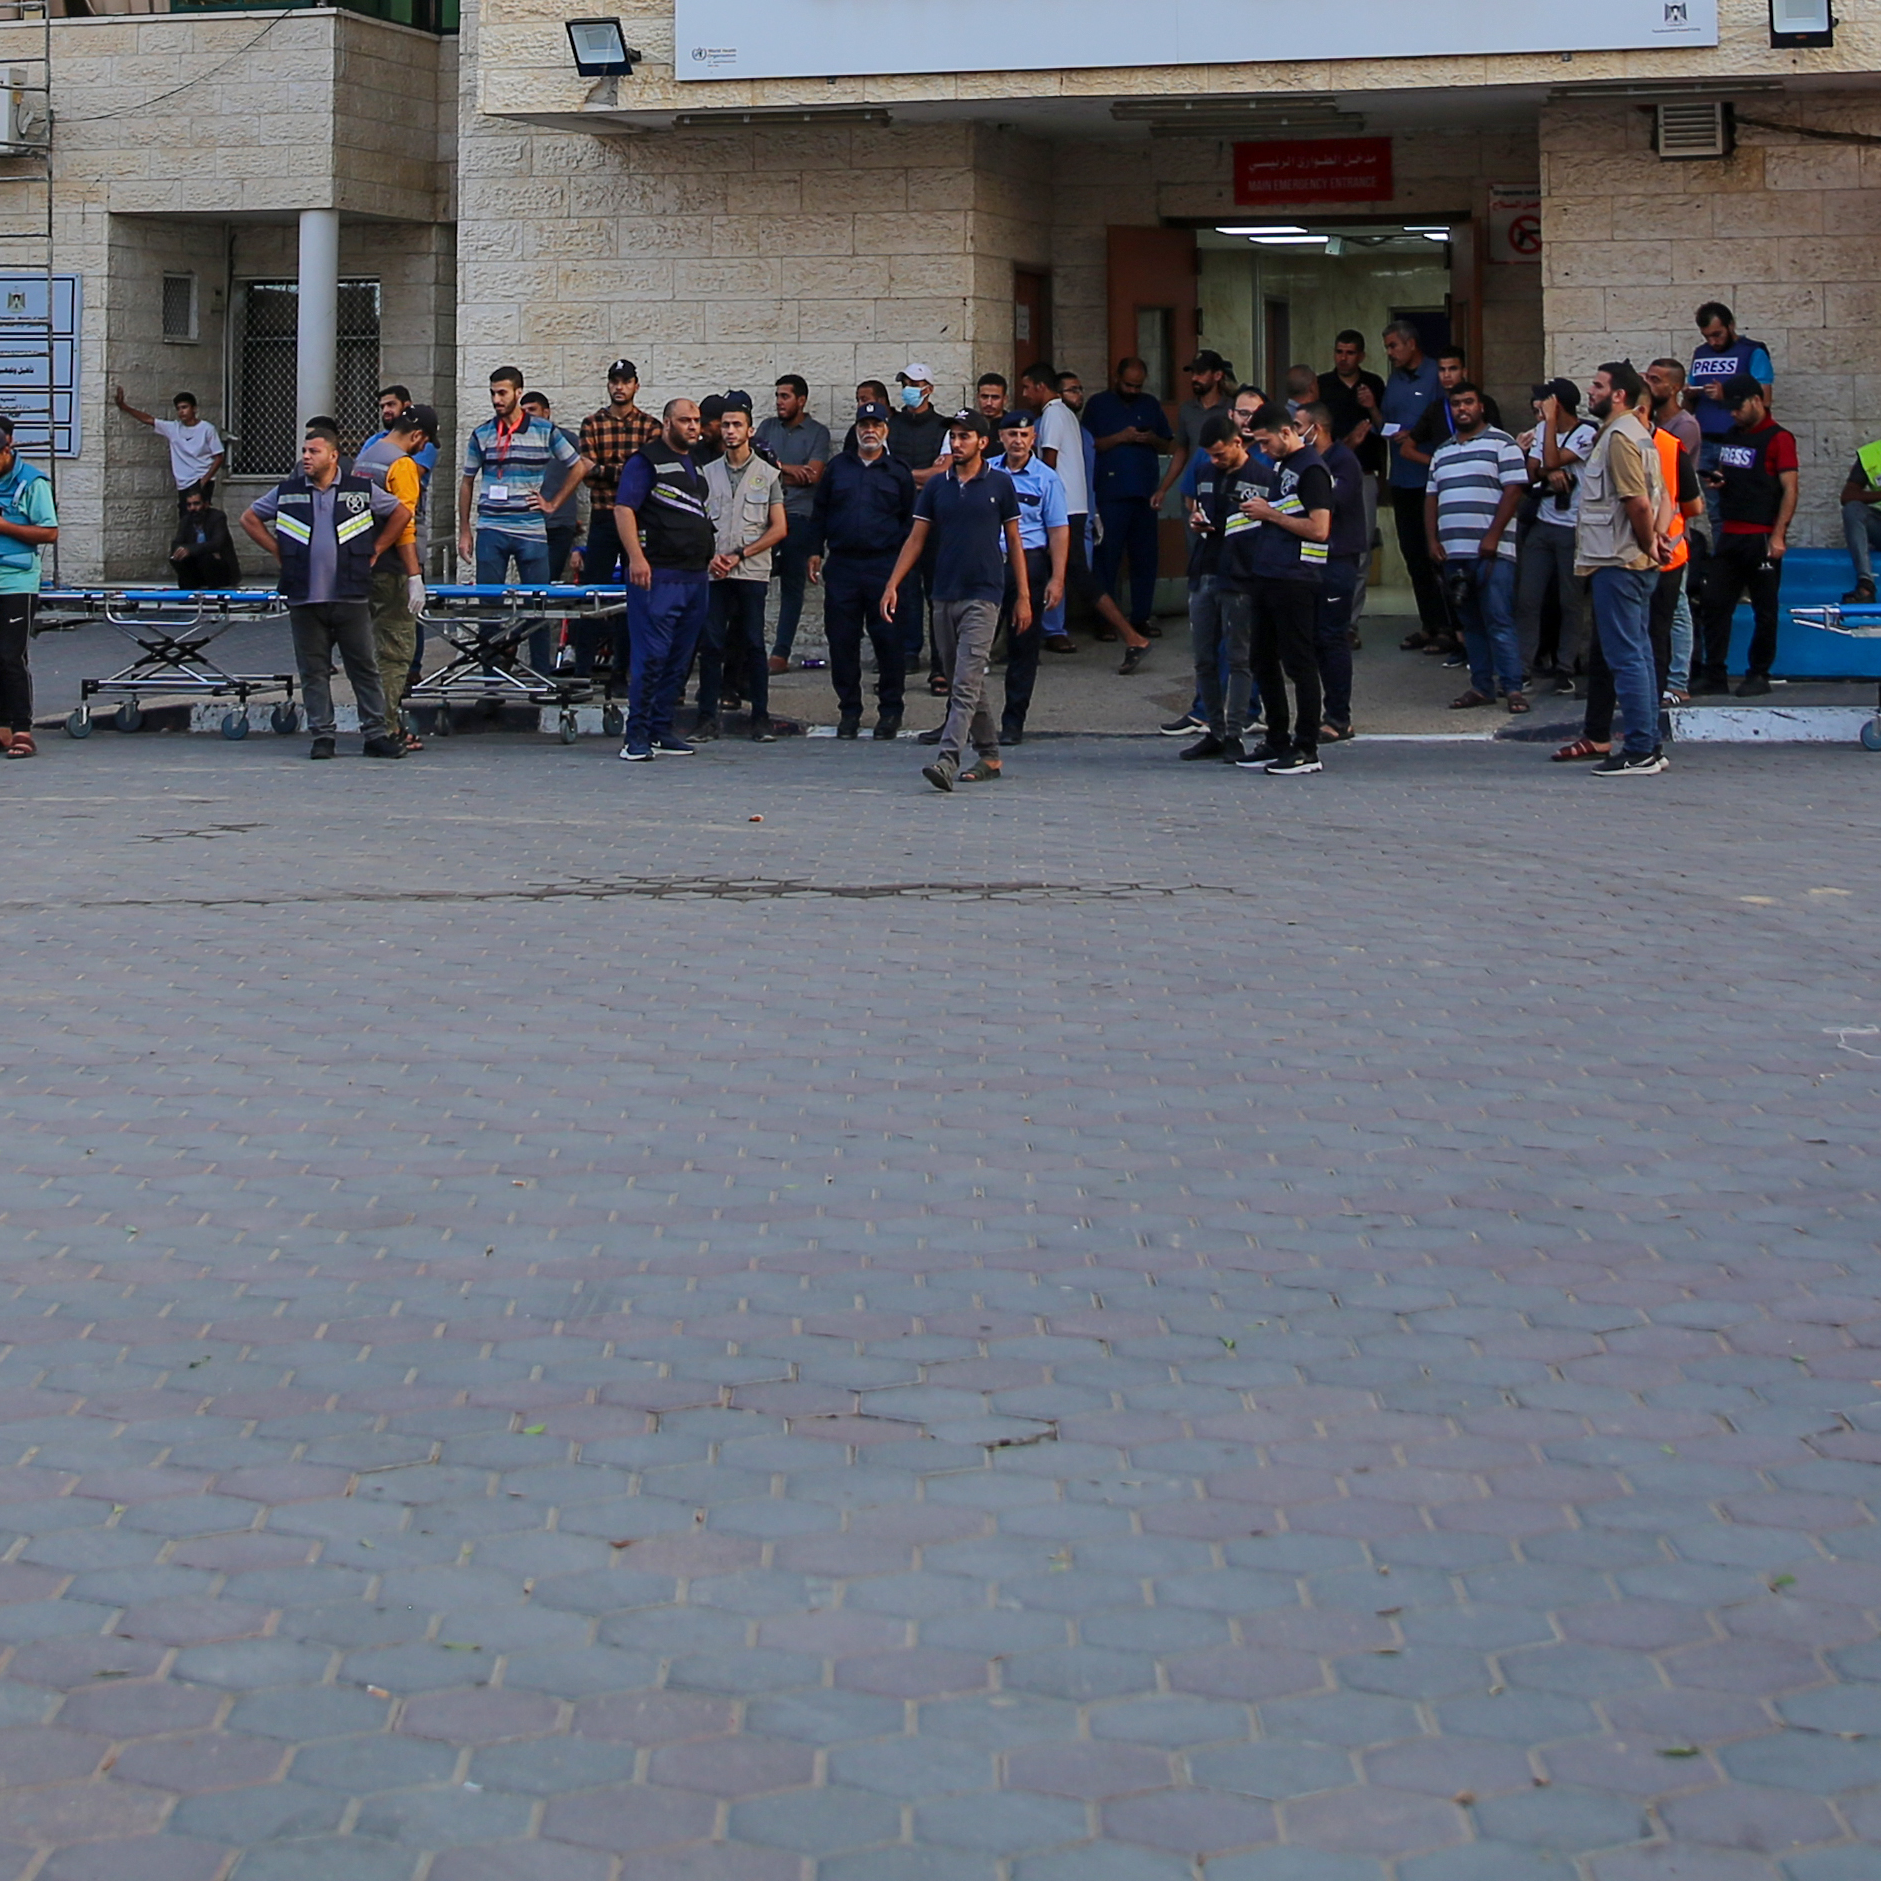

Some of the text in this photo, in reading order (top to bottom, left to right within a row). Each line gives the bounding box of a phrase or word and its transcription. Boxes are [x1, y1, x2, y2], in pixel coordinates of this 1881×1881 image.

[1248, 176, 1376, 191] MAIN EMERGENCY ENTRANCE
[1693, 360, 1737, 373] PRESS
[1719, 446, 1752, 466] PRESS
